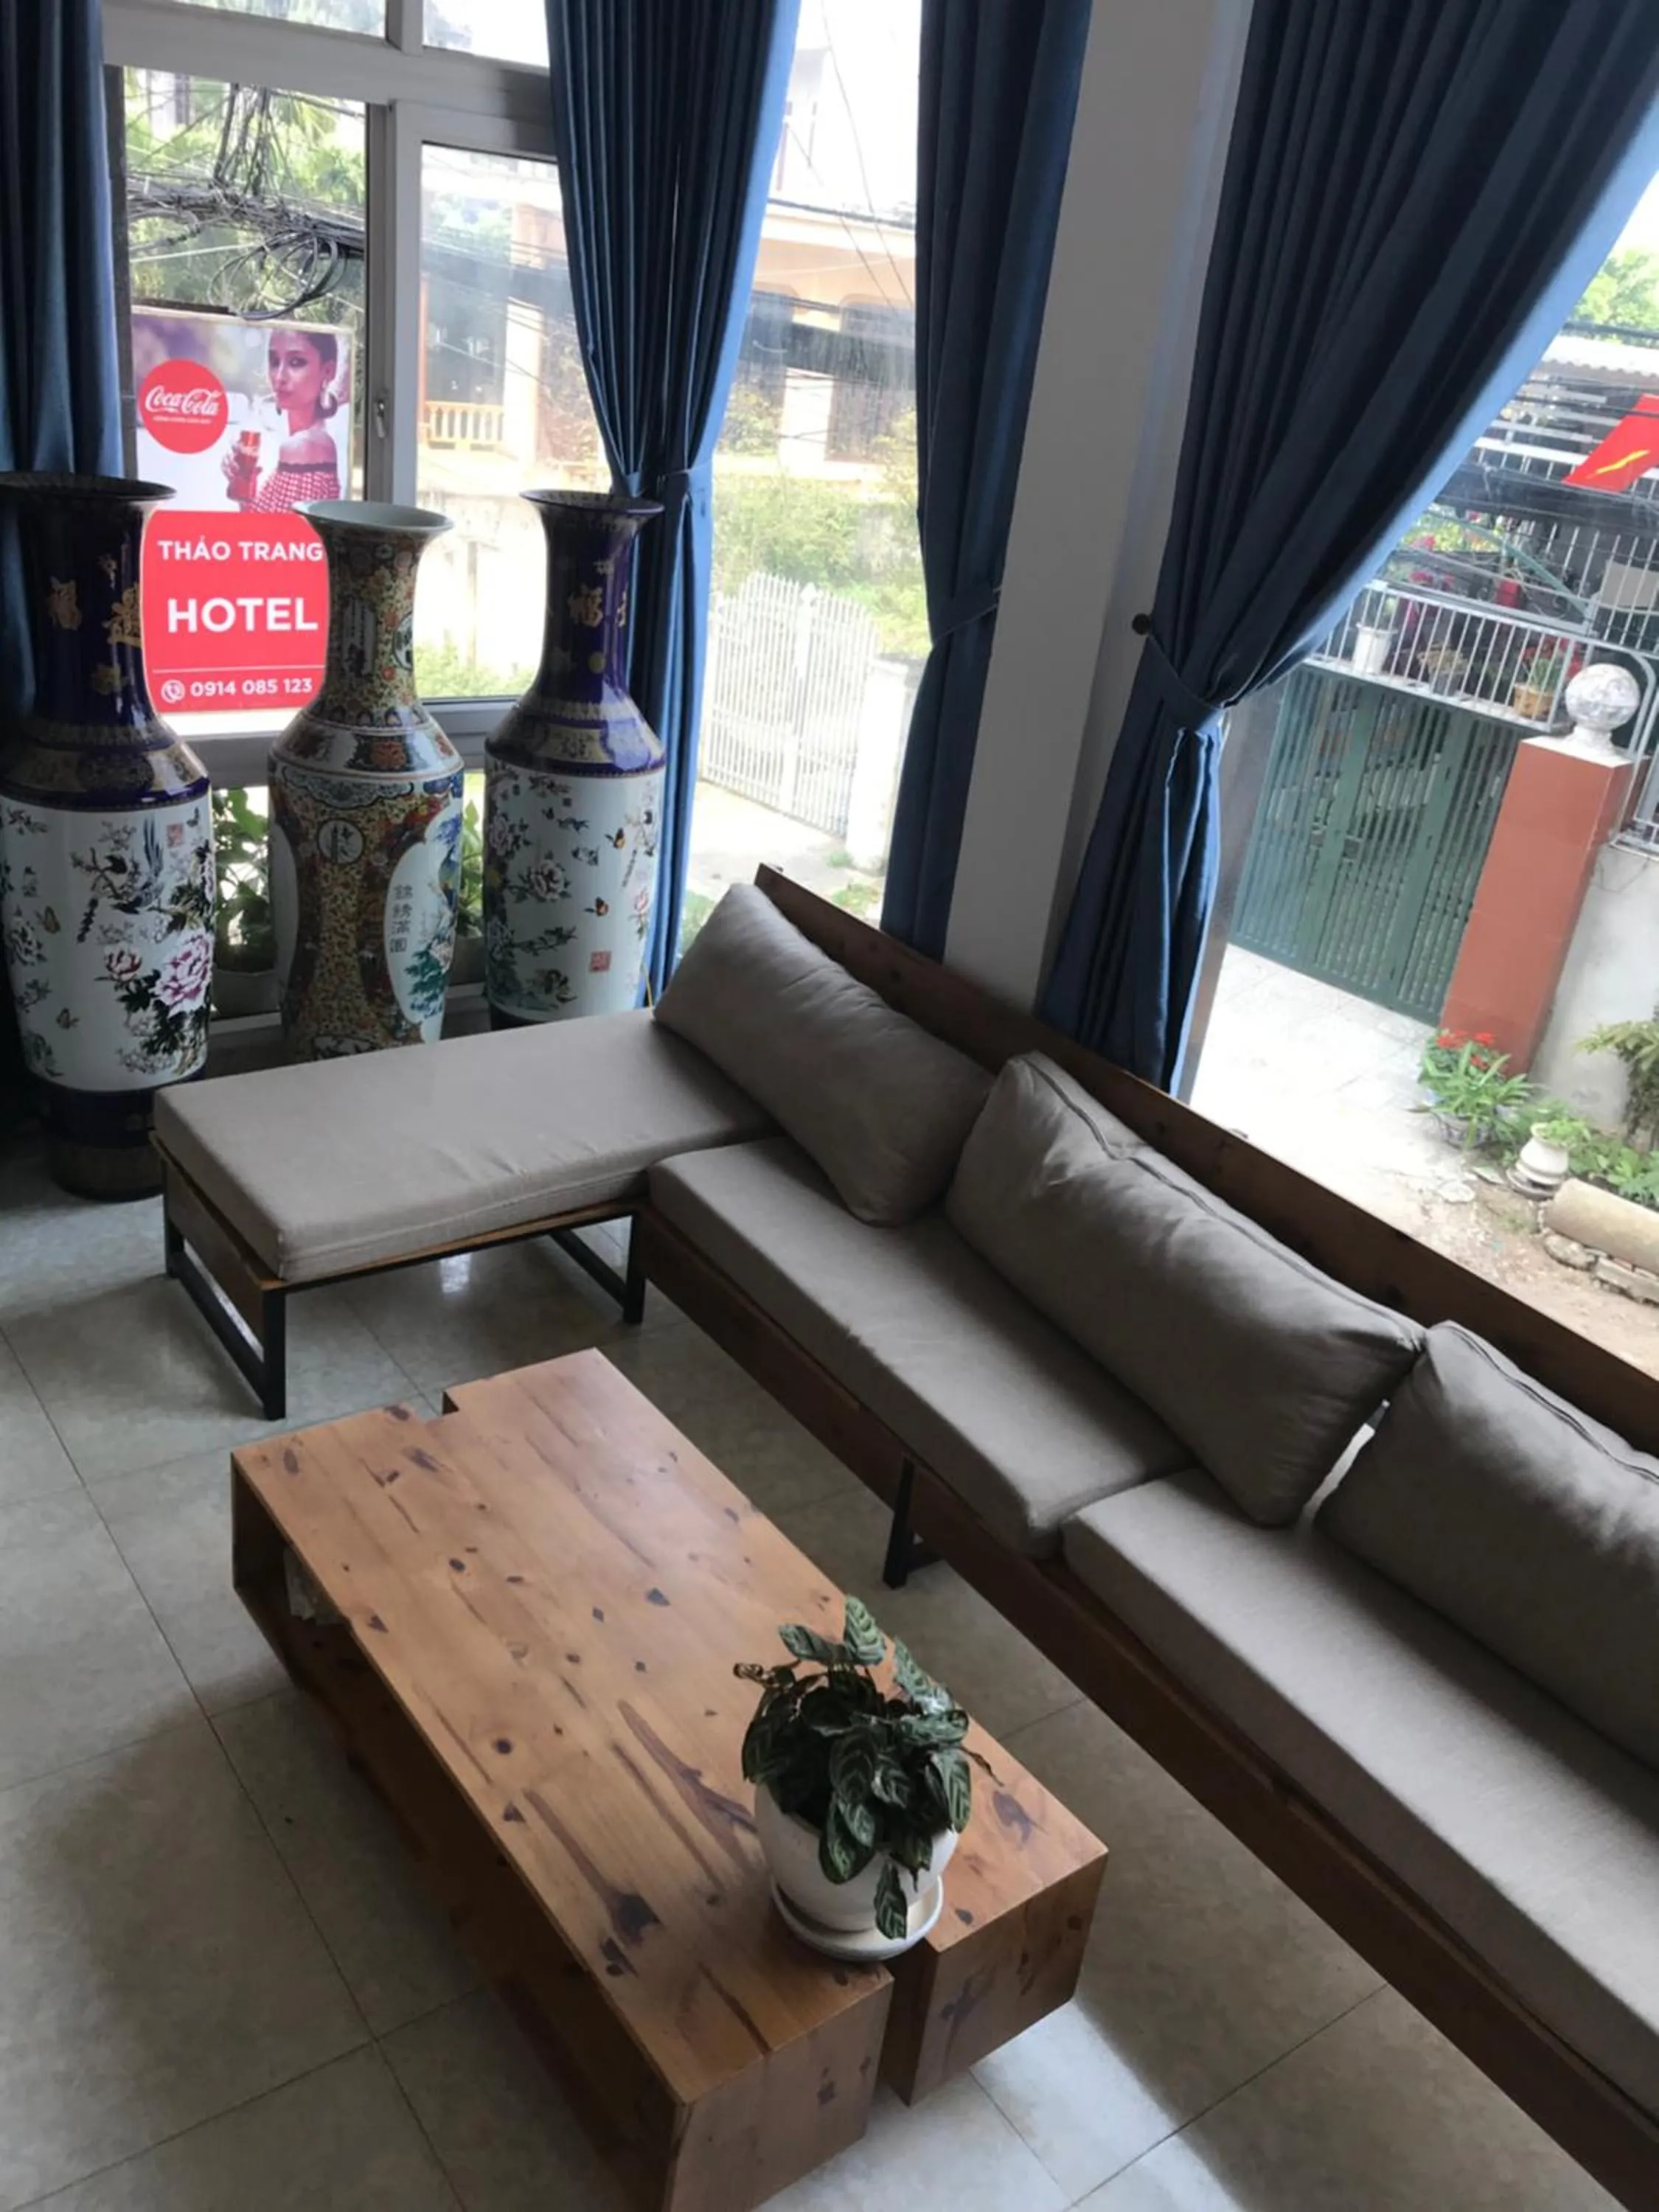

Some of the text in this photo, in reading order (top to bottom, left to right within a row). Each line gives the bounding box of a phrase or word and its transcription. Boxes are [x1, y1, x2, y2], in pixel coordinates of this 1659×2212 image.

[158, 535, 323, 561] THẢO TRANG
[167, 597, 319, 633] HOTEL
[190, 678, 312, 696] 0914 085 123
